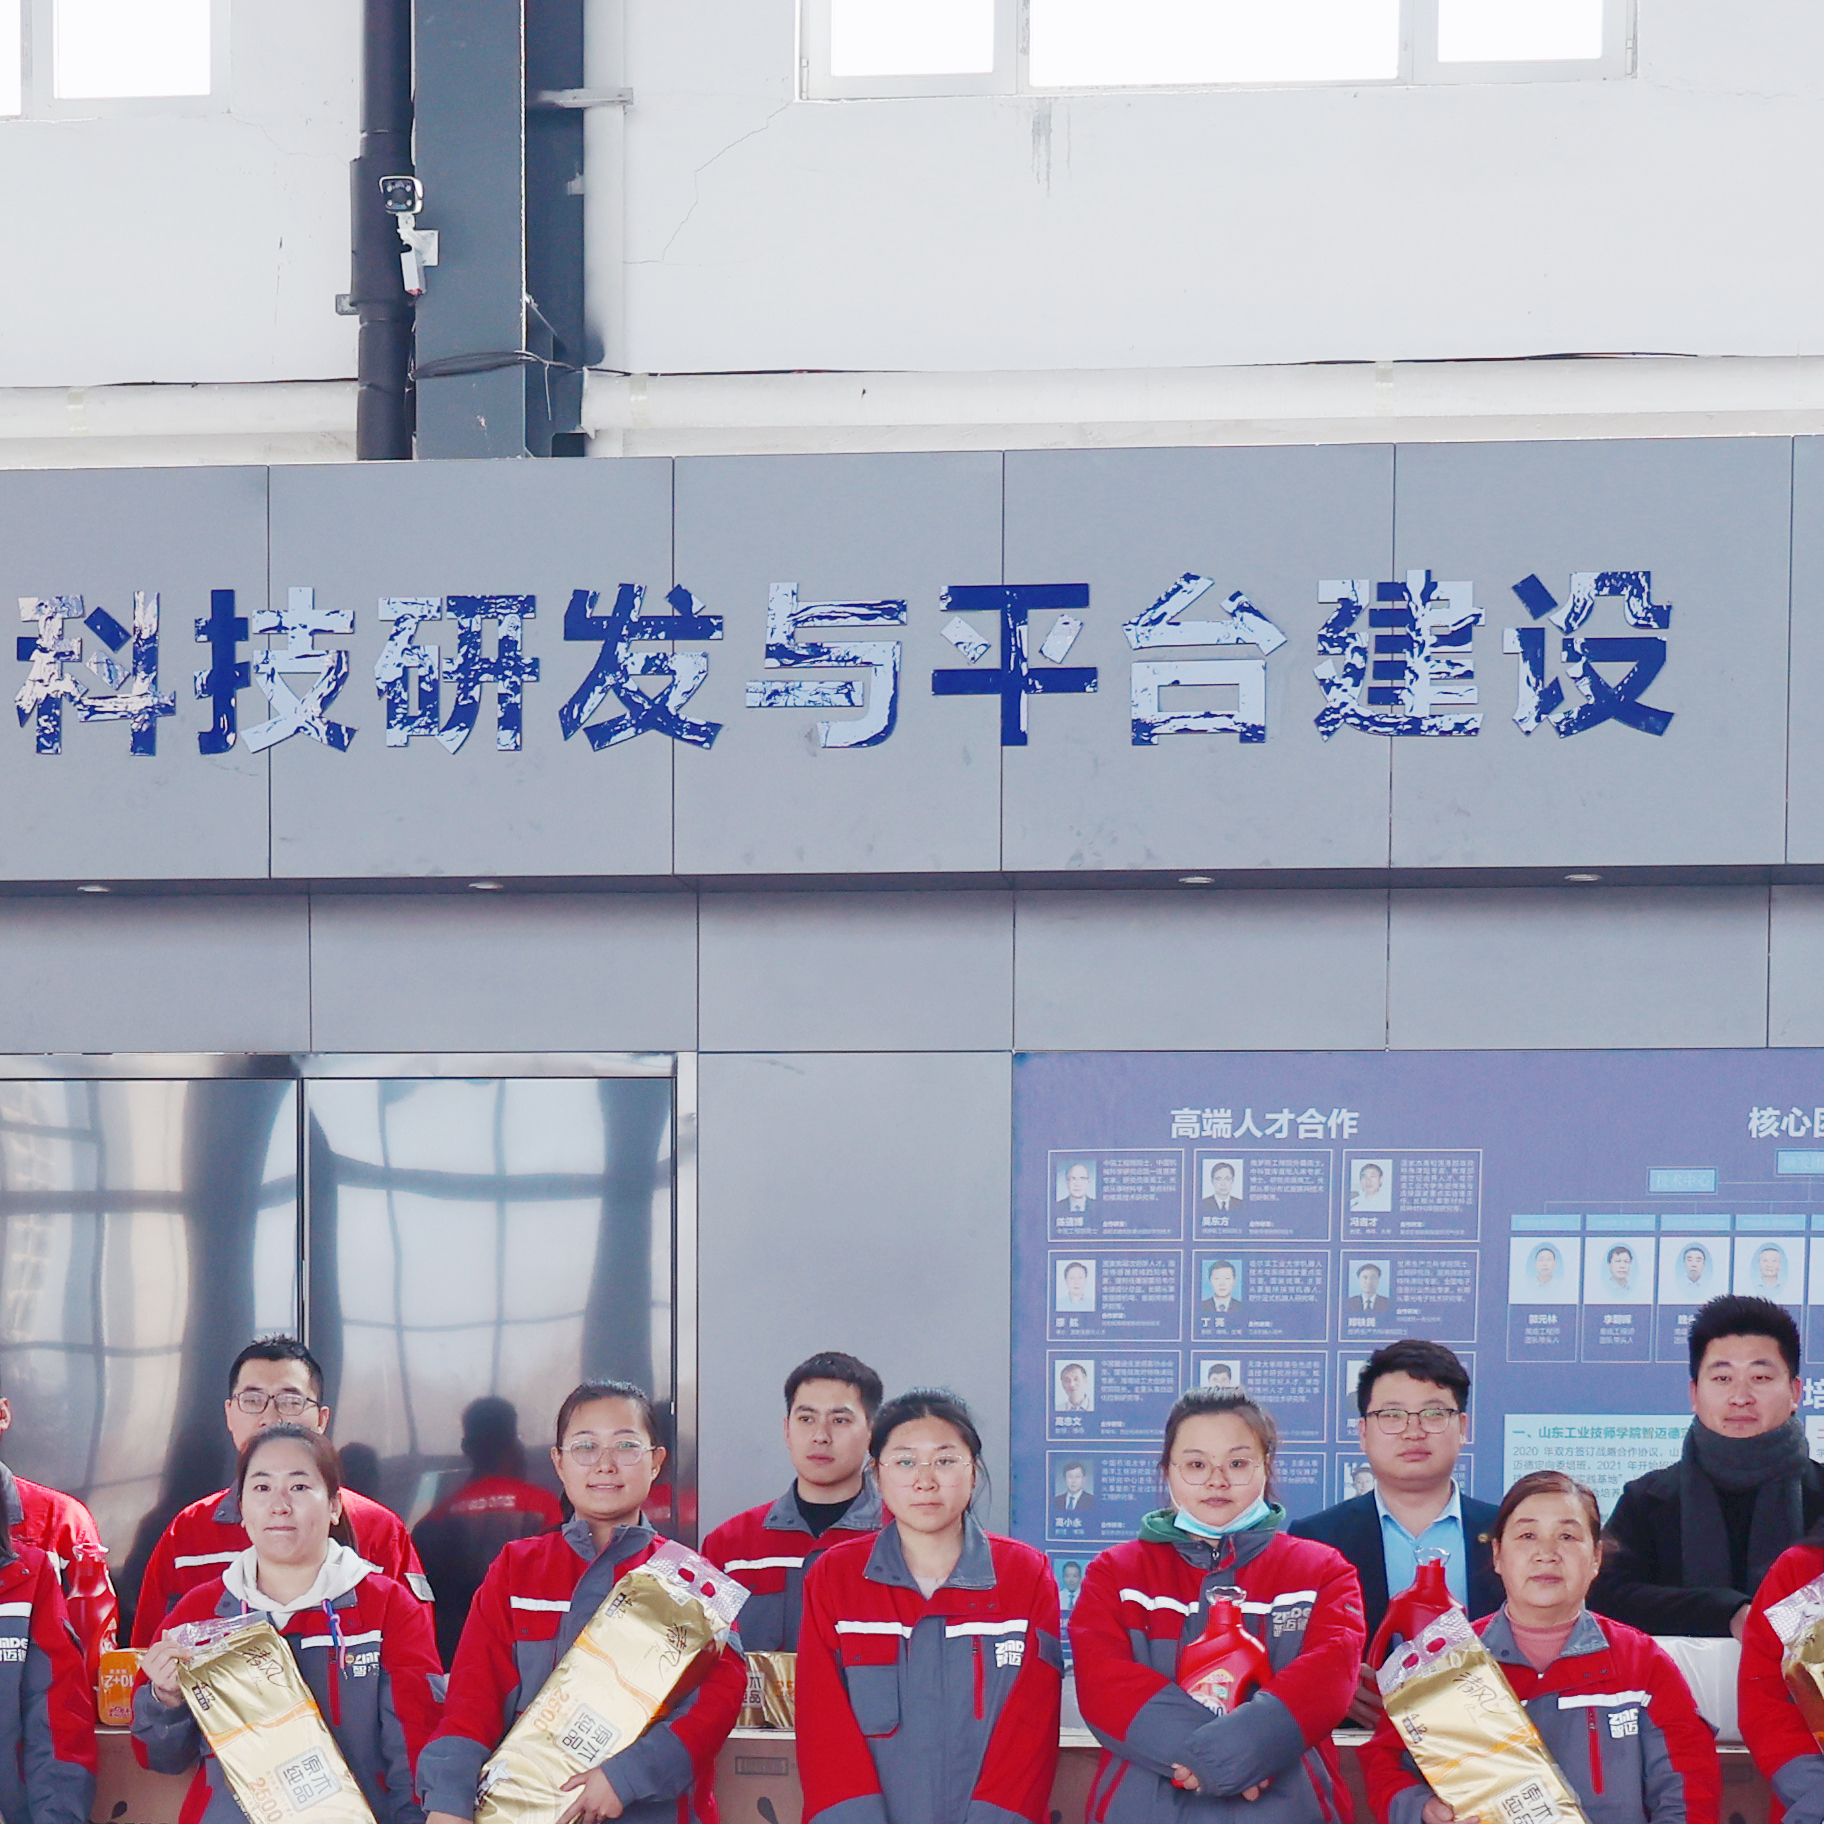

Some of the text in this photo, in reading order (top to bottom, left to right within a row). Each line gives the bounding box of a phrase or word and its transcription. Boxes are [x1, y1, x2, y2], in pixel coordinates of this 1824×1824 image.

[14, 569, 1676, 757] 科技研发与平台建设
[1169, 1107, 1360, 1140] 高端人才合作
[561, 1711, 595, 1750] 纯品
[580, 1724, 614, 1765] 原木
[283, 1764, 315, 1805] 纯品
[302, 1754, 334, 1795] 原木
[1521, 1782, 1553, 1823] 原木
